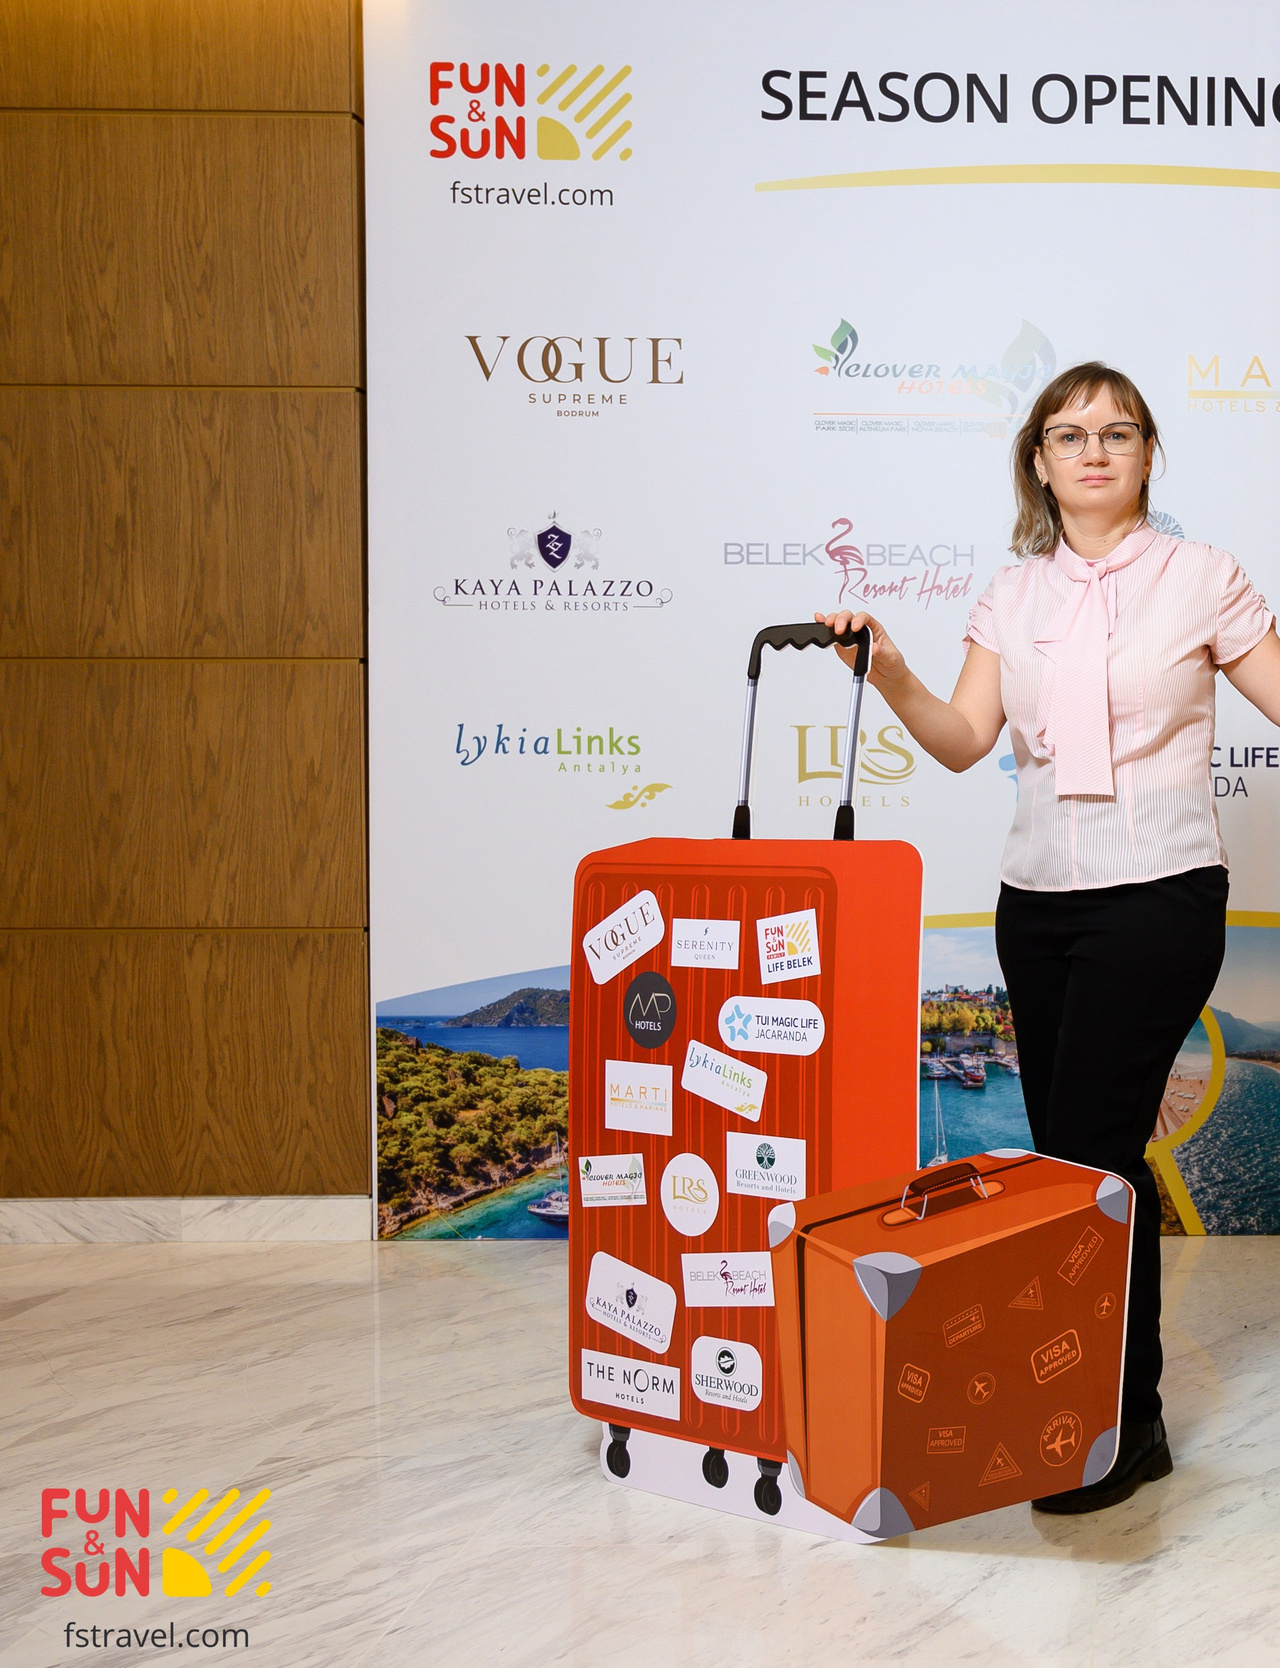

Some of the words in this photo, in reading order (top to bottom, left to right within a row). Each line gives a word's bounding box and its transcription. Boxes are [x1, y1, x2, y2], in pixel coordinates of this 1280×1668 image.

[429, 61, 526, 108] FUN
[760, 69, 1009, 125] SEASON
[466, 99, 486, 122] &
[429, 114, 526, 160] SUN
[450, 180, 614, 206] fstravel.com
[465, 335, 685, 385] VOGUE
[844, 363, 941, 378] CLOVER
[897, 380, 987, 395] HOTELS
[528, 392, 629, 406] SUPREME
[1187, 400, 1267, 413] HOTELS
[556, 409, 600, 418] BODRUM
[724, 542, 826, 566] BELEK
[866, 543, 974, 567] BEACH
[453, 579, 522, 596] KAYA
[533, 579, 654, 597] PALAZZO
[834, 567, 917, 604] Resort
[917, 565, 973, 611] Hotel
[479, 600, 537, 611] HOTELS
[545, 600, 556, 611] &
[563, 601, 629, 612] RESORTS
[1230, 747, 1280, 768] LIFE
[558, 761, 642, 775] Antalya
[798, 795, 910, 807] HOELS
[588, 901, 655, 960] VOGUE
[764, 925, 784, 940] FUN
[676, 940, 734, 952] SERENITY
[766, 939, 785, 954] SUN
[767, 961, 785, 973] LIFE
[786, 956, 813, 970] BELEK
[635, 1020, 662, 1031] HOTELS
[755, 1015, 770, 1026] TUI
[772, 1016, 798, 1028] MAGIC
[800, 1018, 819, 1029] LIFE
[754, 1028, 808, 1042] JACARANDA
[610, 1083, 668, 1102] MARTI
[735, 1168, 797, 1186] GREENWOOD
[671, 1174, 708, 1205] LRS
[736, 1180, 759, 1190] Resorts
[775, 1184, 796, 1194] Hotels
[1068, 1244, 1085, 1263] VISA
[1068, 1235, 1099, 1280] APPROVED
[690, 1271, 719, 1282] BELEK
[732, 1270, 766, 1281] BEACH
[596, 1296, 618, 1315] KAYA
[620, 1309, 661, 1337] PALAZZO
[948, 1322, 983, 1345] DEPARTURE
[1041, 1340, 1071, 1364] VISA
[1040, 1350, 1077, 1377] APPROVED
[587, 1361, 615, 1382] THE
[623, 1368, 675, 1395] NORM
[695, 1373, 759, 1397] SHERWOOD
[906, 1370, 923, 1387] VISA
[901, 1381, 923, 1397] APPROVED
[615, 1392, 645, 1405] HOTELS
[938, 1430, 953, 1438] VISA
[1042, 1415, 1077, 1442] ARRIVAL
[929, 1438, 963, 1447] APPROVED
